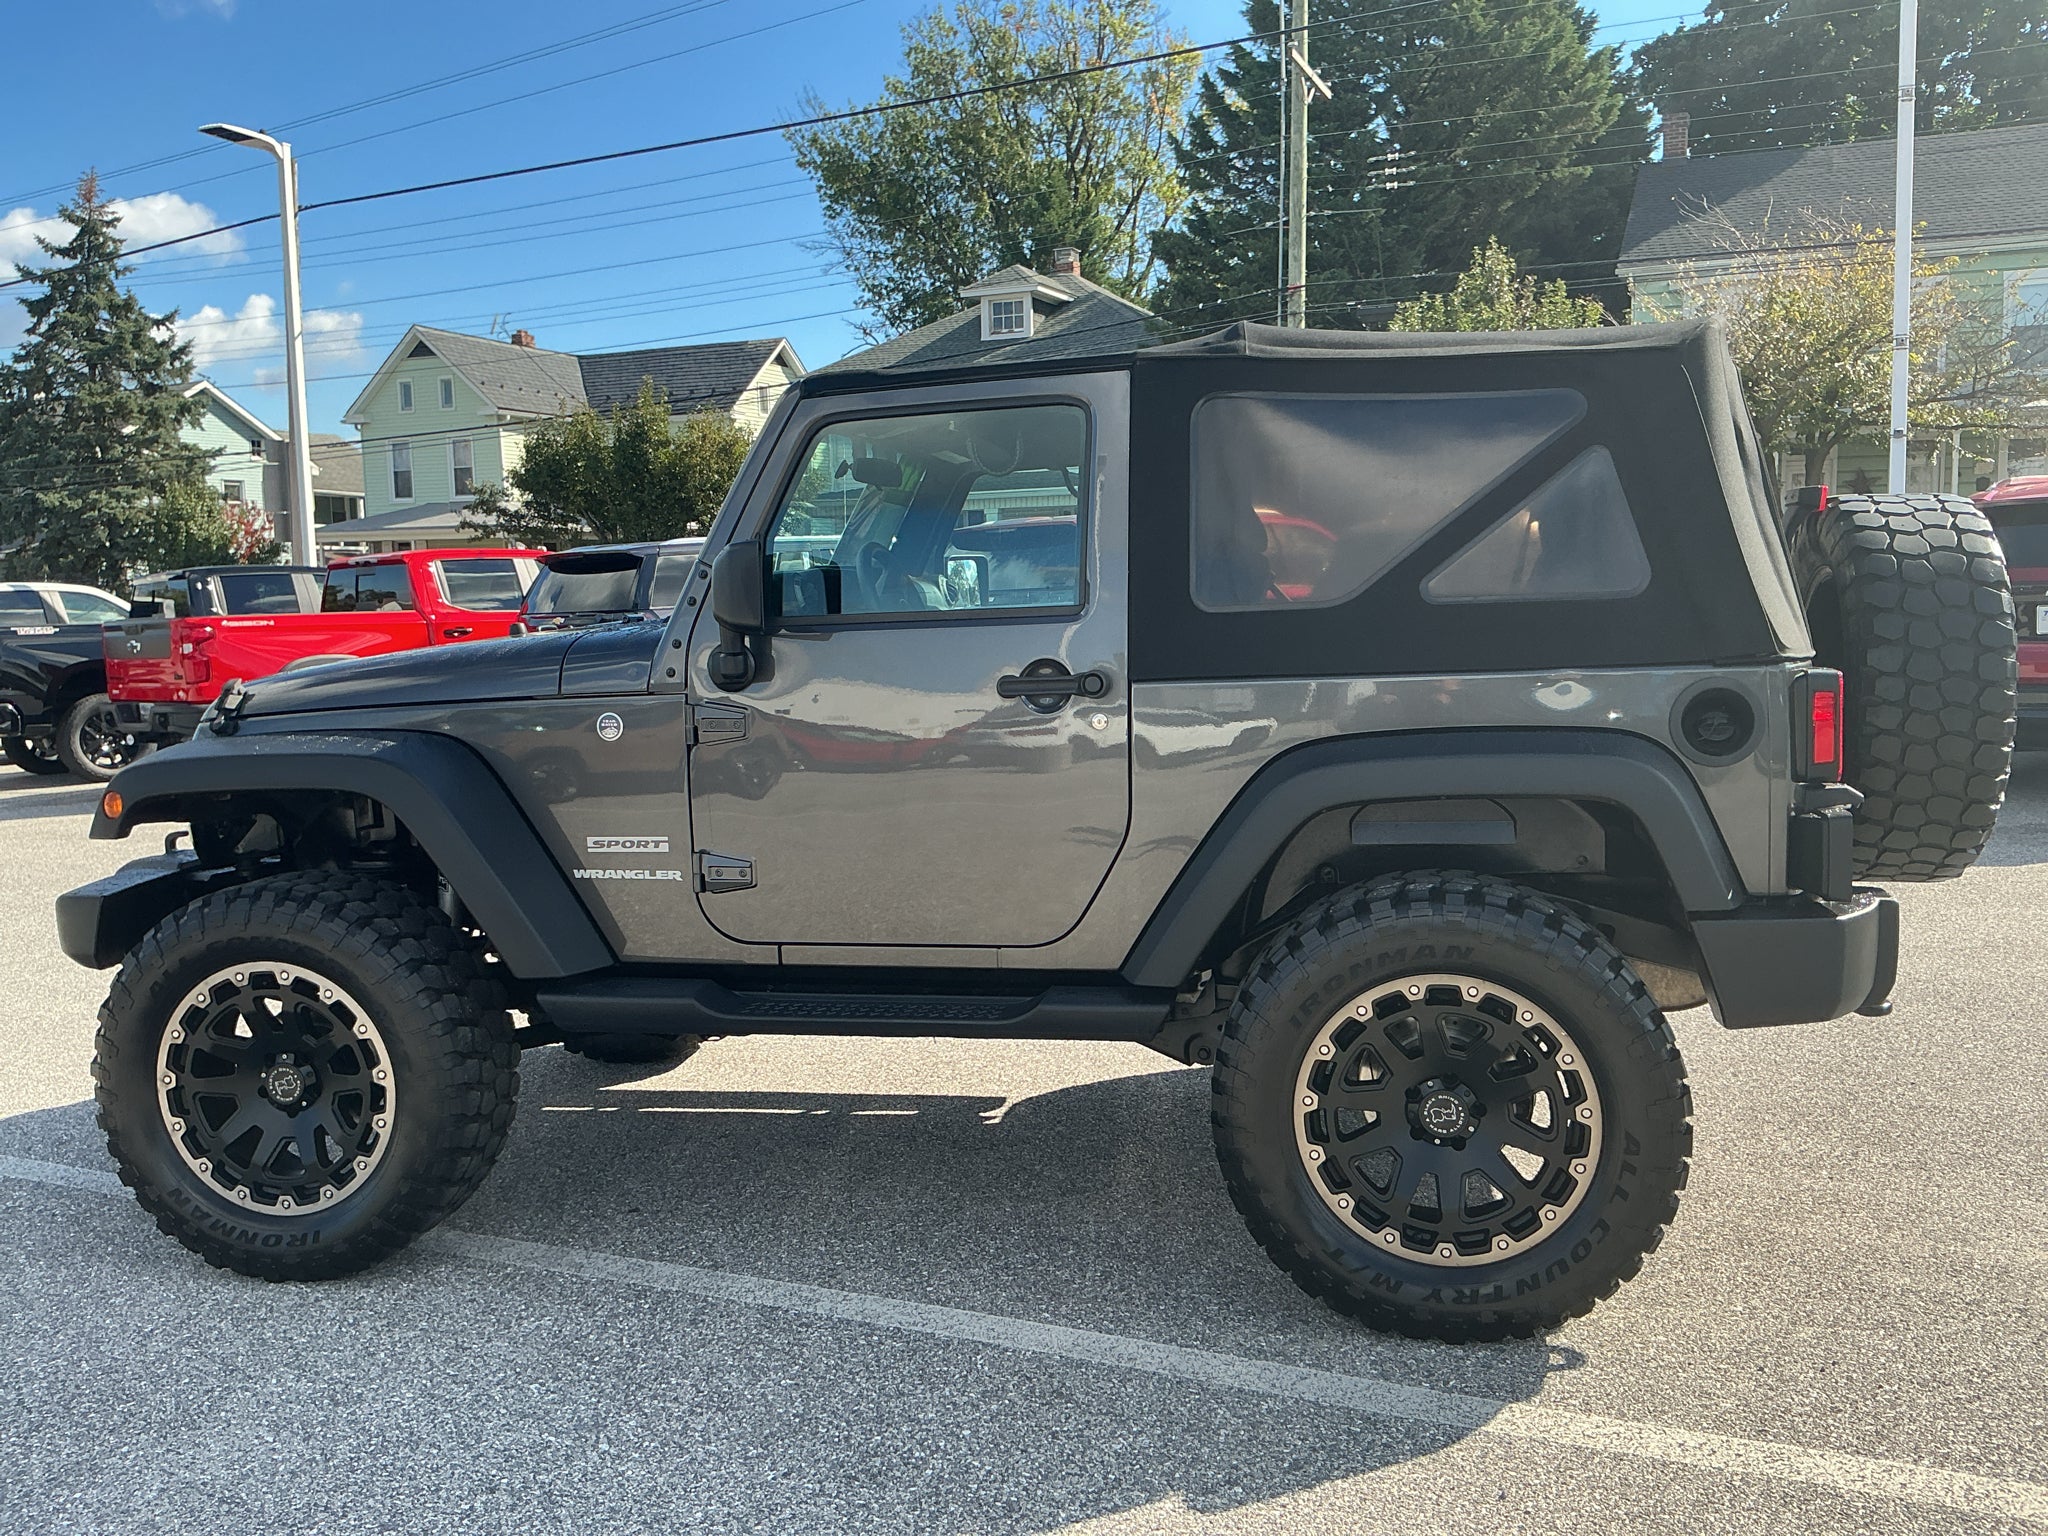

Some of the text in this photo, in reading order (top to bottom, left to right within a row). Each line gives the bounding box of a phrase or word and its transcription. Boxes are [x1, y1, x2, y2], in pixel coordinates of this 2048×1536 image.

[572, 868, 683, 881] WRANGLER
[588, 838, 669, 850] SPORT
[1288, 944, 1475, 1032] IRONMAN
[165, 1187, 321, 1248] IRONMAN
[1321, 1128, 1641, 1305] ALL COUNTRY M/T
